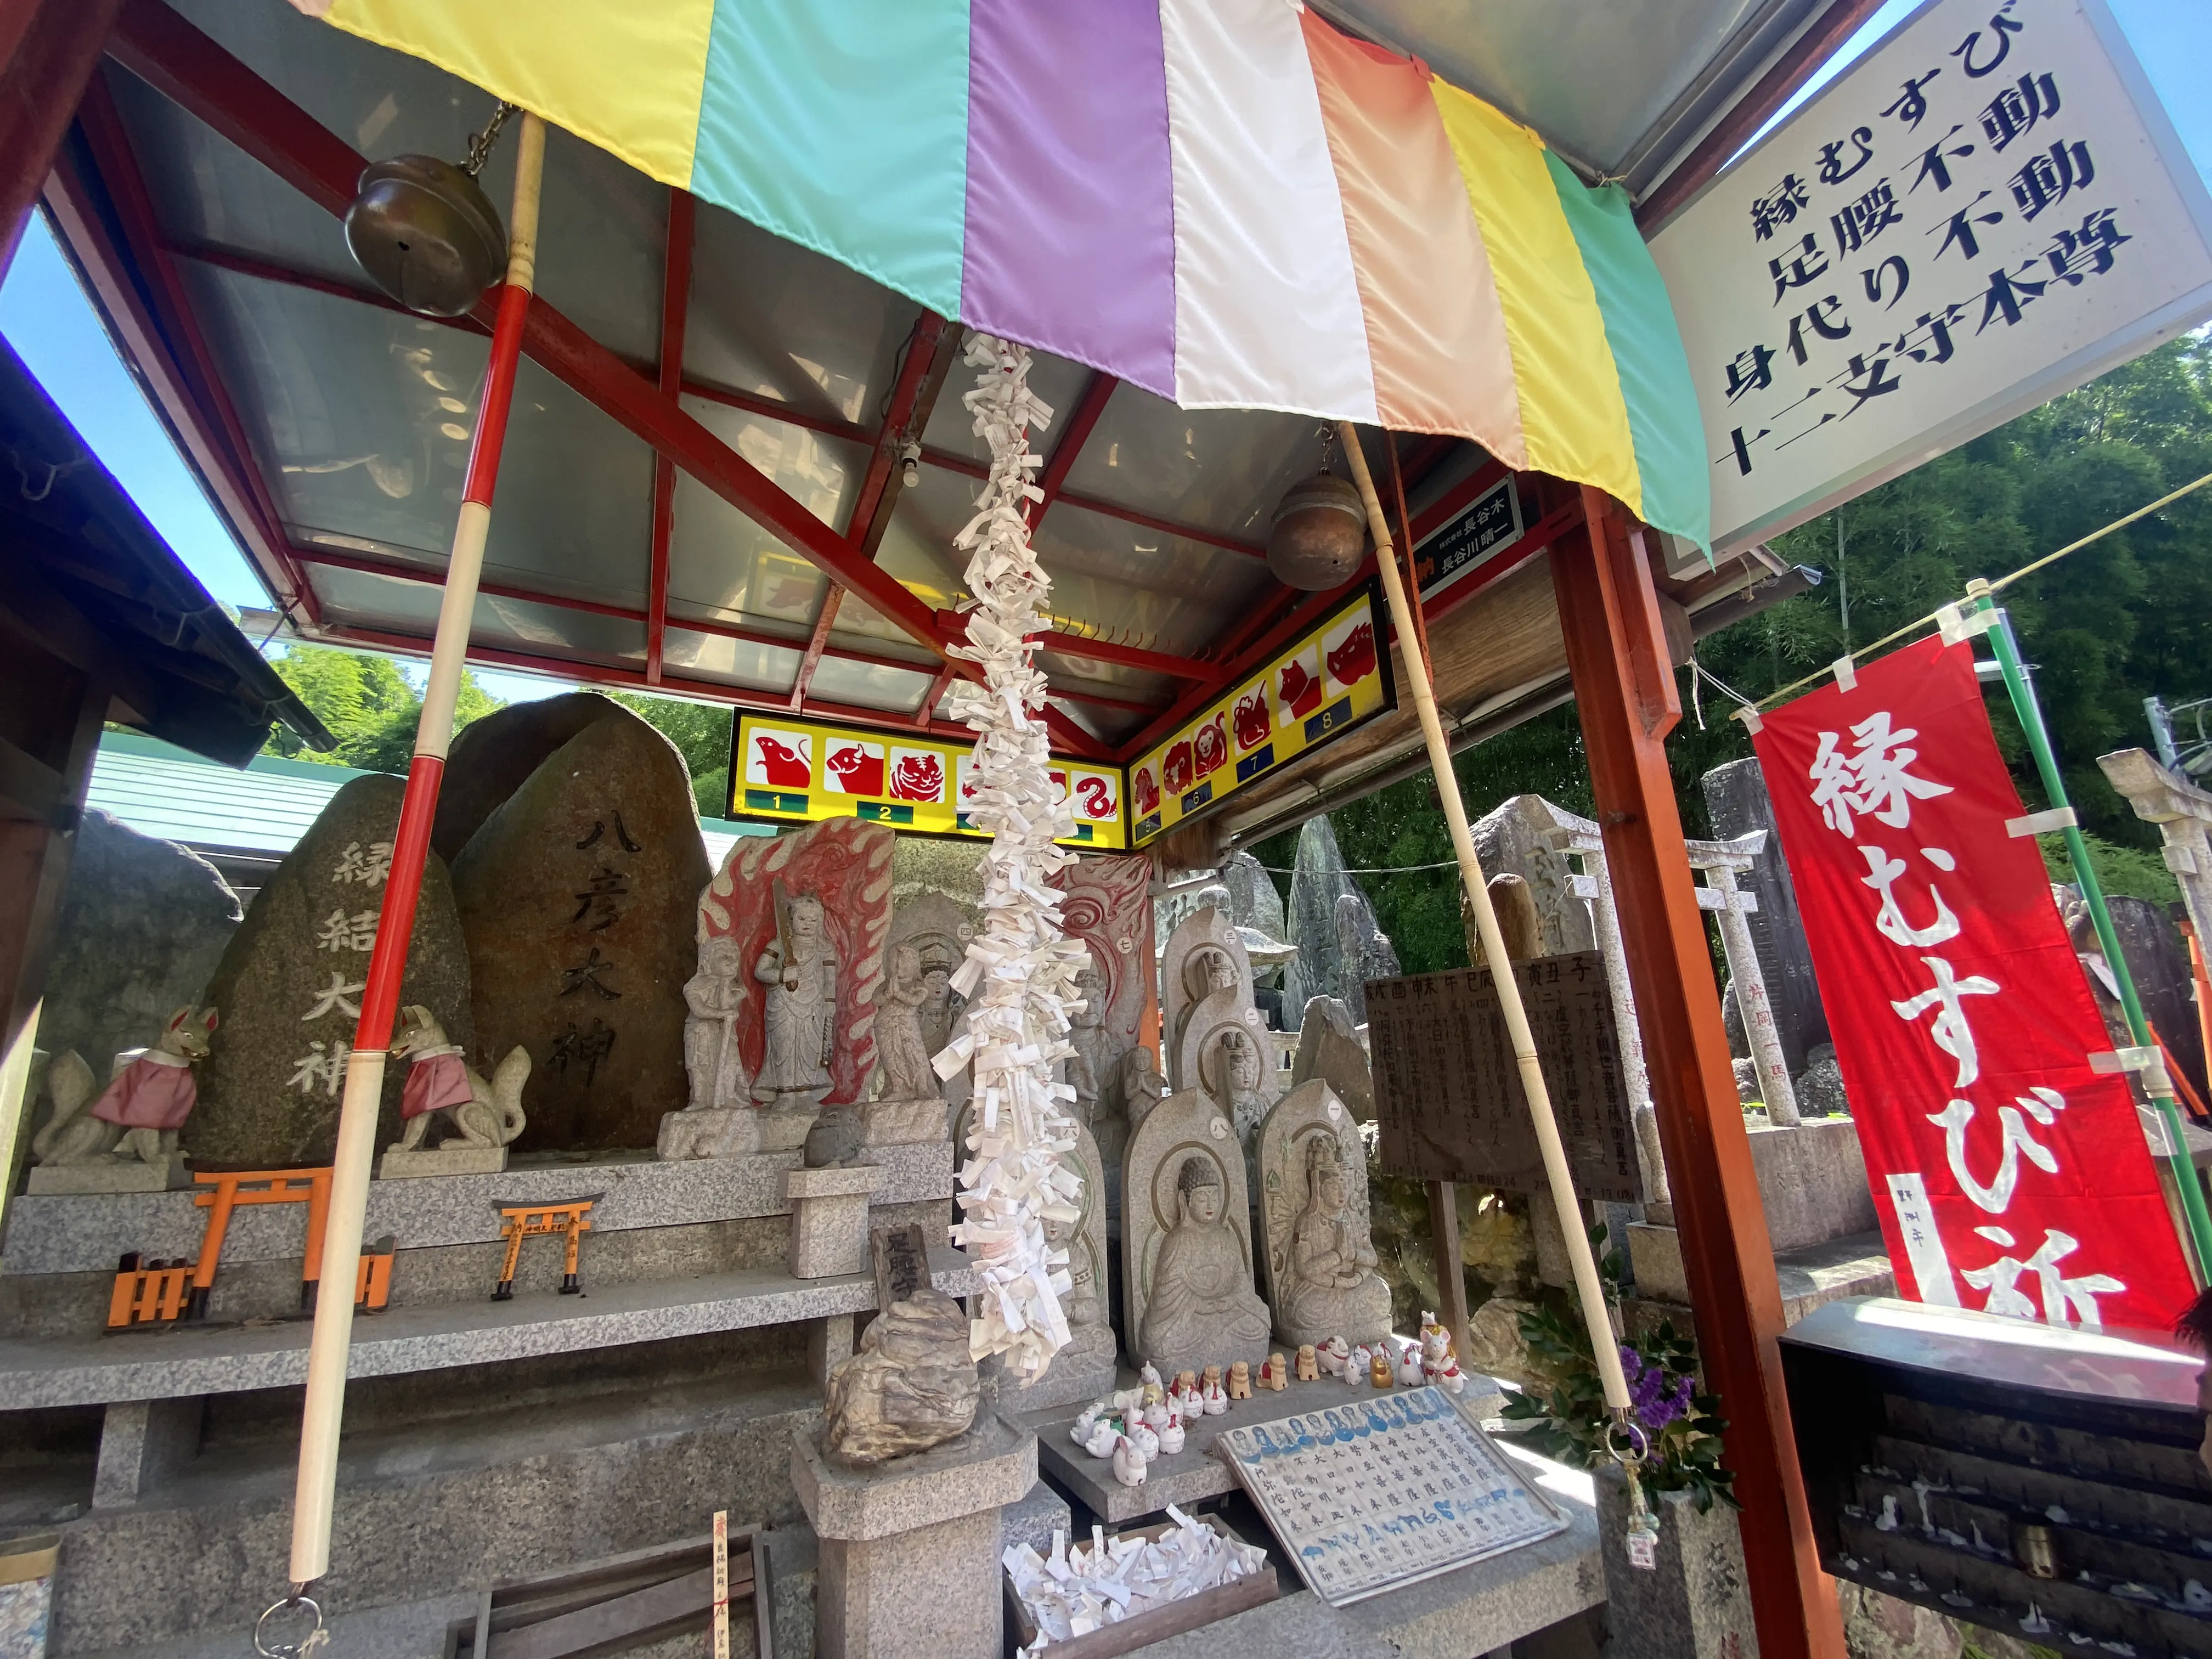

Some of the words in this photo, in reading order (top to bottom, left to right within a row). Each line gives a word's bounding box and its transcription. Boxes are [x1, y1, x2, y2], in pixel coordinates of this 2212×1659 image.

[1751, 0, 2023, 244] 縁むすび
[1768, 72, 2062, 309] 足腰不動
[1724, 138, 2096, 408] 身代り不動
[1715, 207, 2134, 477] 十二支守本尊
[1442, 523, 1508, 574] 長谷川晴一
[1322, 712, 1331, 729] 8
[1250, 756, 1257, 771] 7
[773, 794, 781, 809] 1
[1192, 791, 1199, 805] 6
[879, 806, 891, 820] 2
[1145, 820, 1151, 833] 5
[960, 927, 972, 936] 四
[546, 809, 642, 1088] 八彦大神
[1120, 939, 1131, 951] 七
[1546, 962, 1560, 983] 丑
[1570, 957, 1591, 983] 子
[1444, 975, 1458, 995] 午
[1749, 984, 1786, 1081] 片岡一馬
